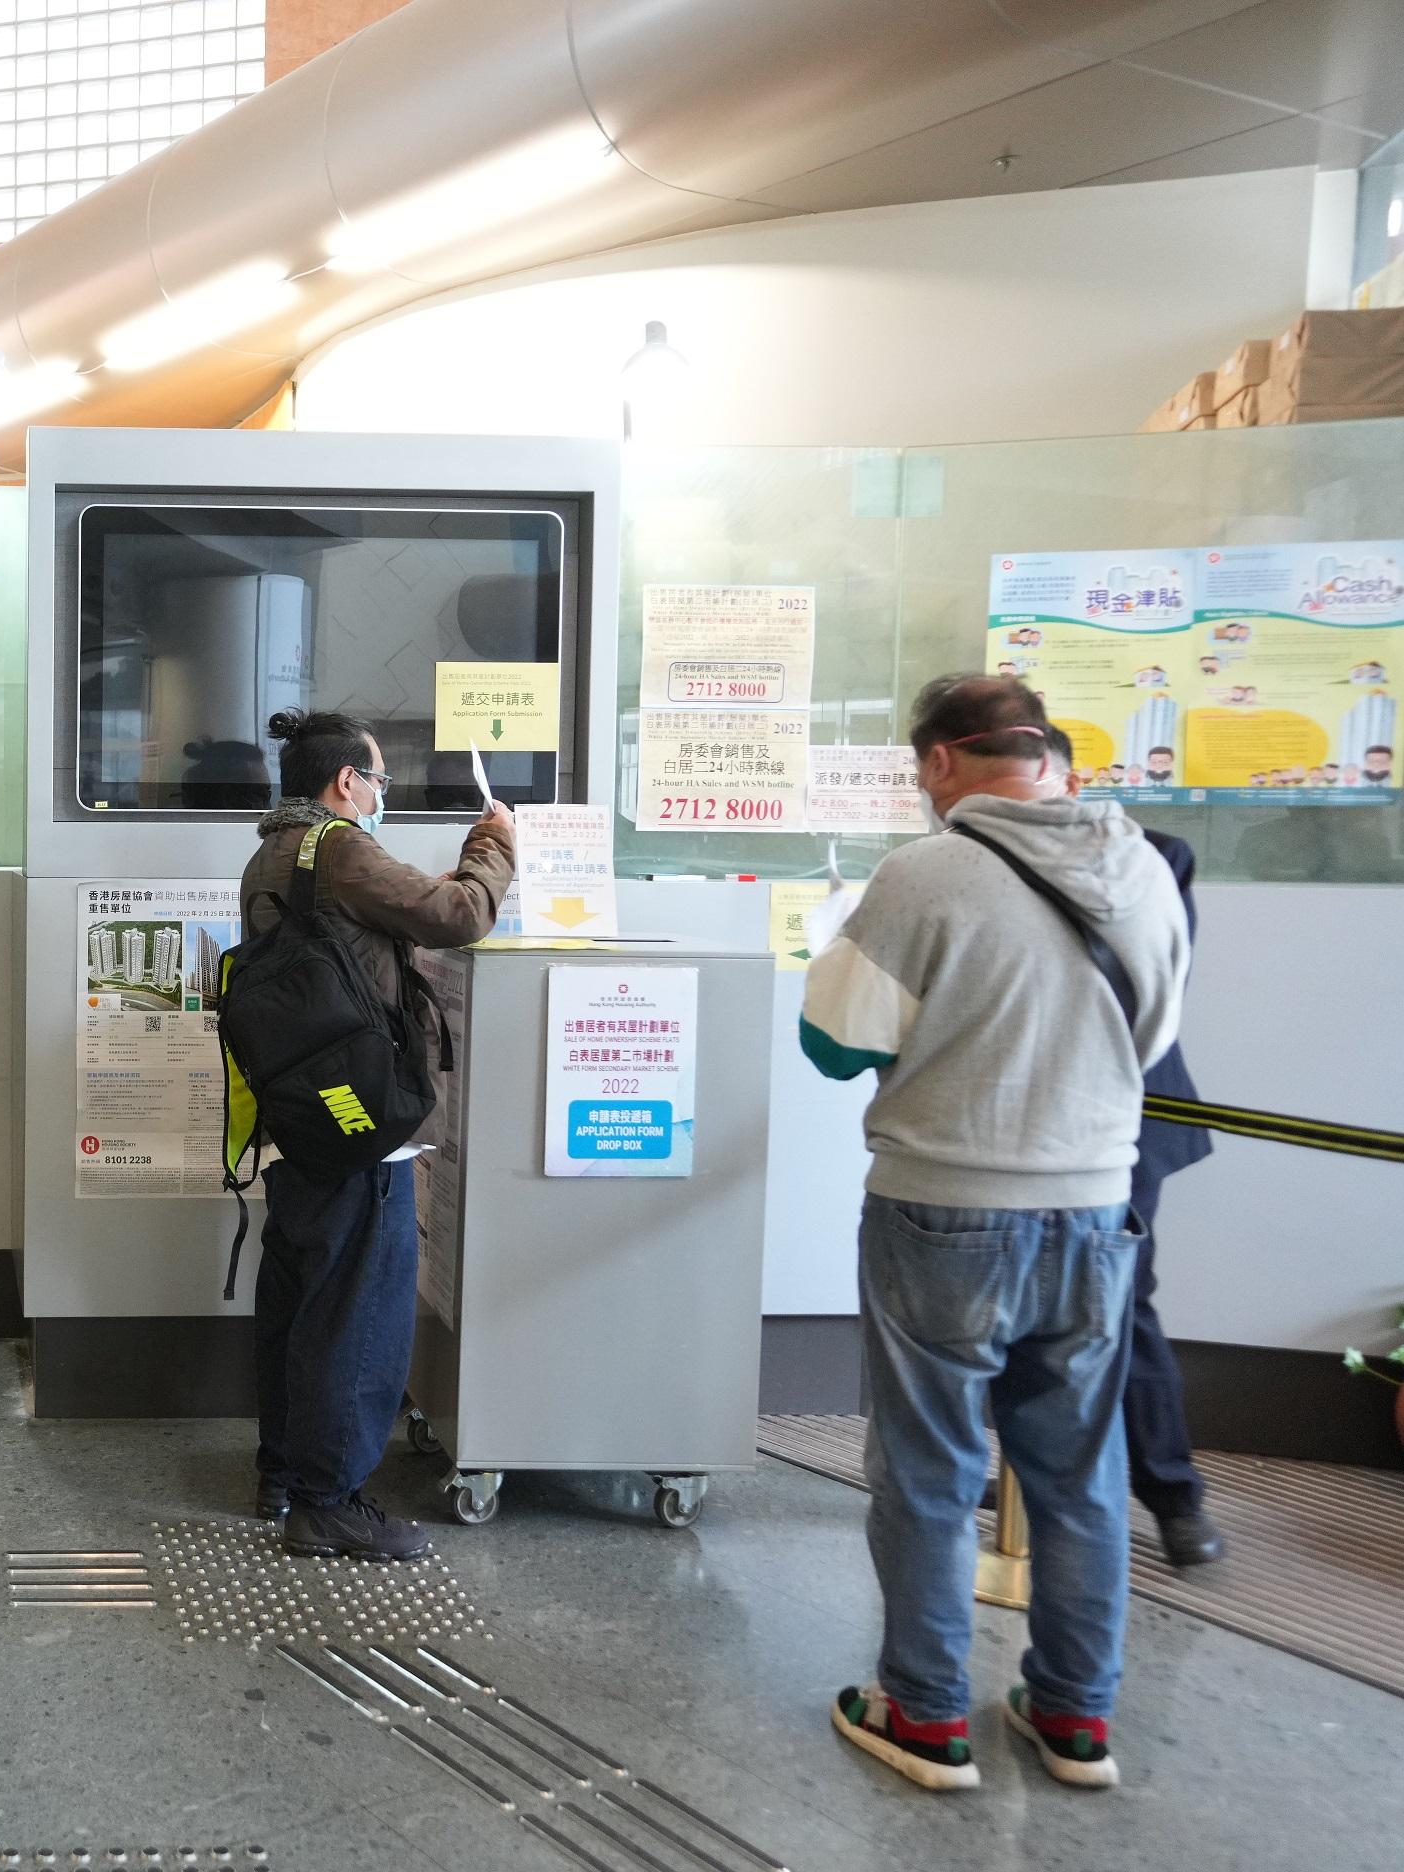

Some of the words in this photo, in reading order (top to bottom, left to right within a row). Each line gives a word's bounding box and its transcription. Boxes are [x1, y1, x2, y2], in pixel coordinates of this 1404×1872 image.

[1332, 575, 1392, 593] Cash
[778, 599, 808, 610] 2022
[1085, 588, 1182, 613] 現金津貼
[1297, 591, 1397, 611] Allowance
[686, 682, 723, 696] 2712
[728, 683, 766, 697] 8000
[461, 692, 535, 706] 遞交申請表
[773, 723, 803, 734] 2022
[678, 743, 770, 759] 房委會銷售及
[664, 759, 786, 775] 白居二24小時熱線
[652, 779, 683, 787] 24-hour
[686, 779, 700, 787] HA
[702, 779, 722, 787] Sales
[725, 779, 739, 787] and
[742, 779, 765, 788] WSM
[768, 780, 794, 788] hotline
[815, 772, 918, 786] 派發/遞交申請表
[659, 798, 716, 819] 2712
[725, 798, 783, 820] 8000
[890, 799, 910, 808] 7:00
[540, 849, 574, 860] 申請表
[503, 893, 518, 901] ject
[88, 903, 131, 913] 重售單位
[564, 1020, 680, 1033] 出售居者有其屋計劃單位
[569, 1049, 675, 1062] 白表居屋第二市場計劃
[602, 1078, 640, 1094] 2022
[318, 1084, 376, 1135] NIKE
[589, 1110, 652, 1123] 申請表投遞箱
[576, 1126, 636, 1136] APPLICATION
[637, 1126, 664, 1136] FORM
[597, 1140, 621, 1150] DROP
[623, 1140, 642, 1150] BOX
[105, 1156, 127, 1164] 8101
[130, 1156, 152, 1164] 2238
